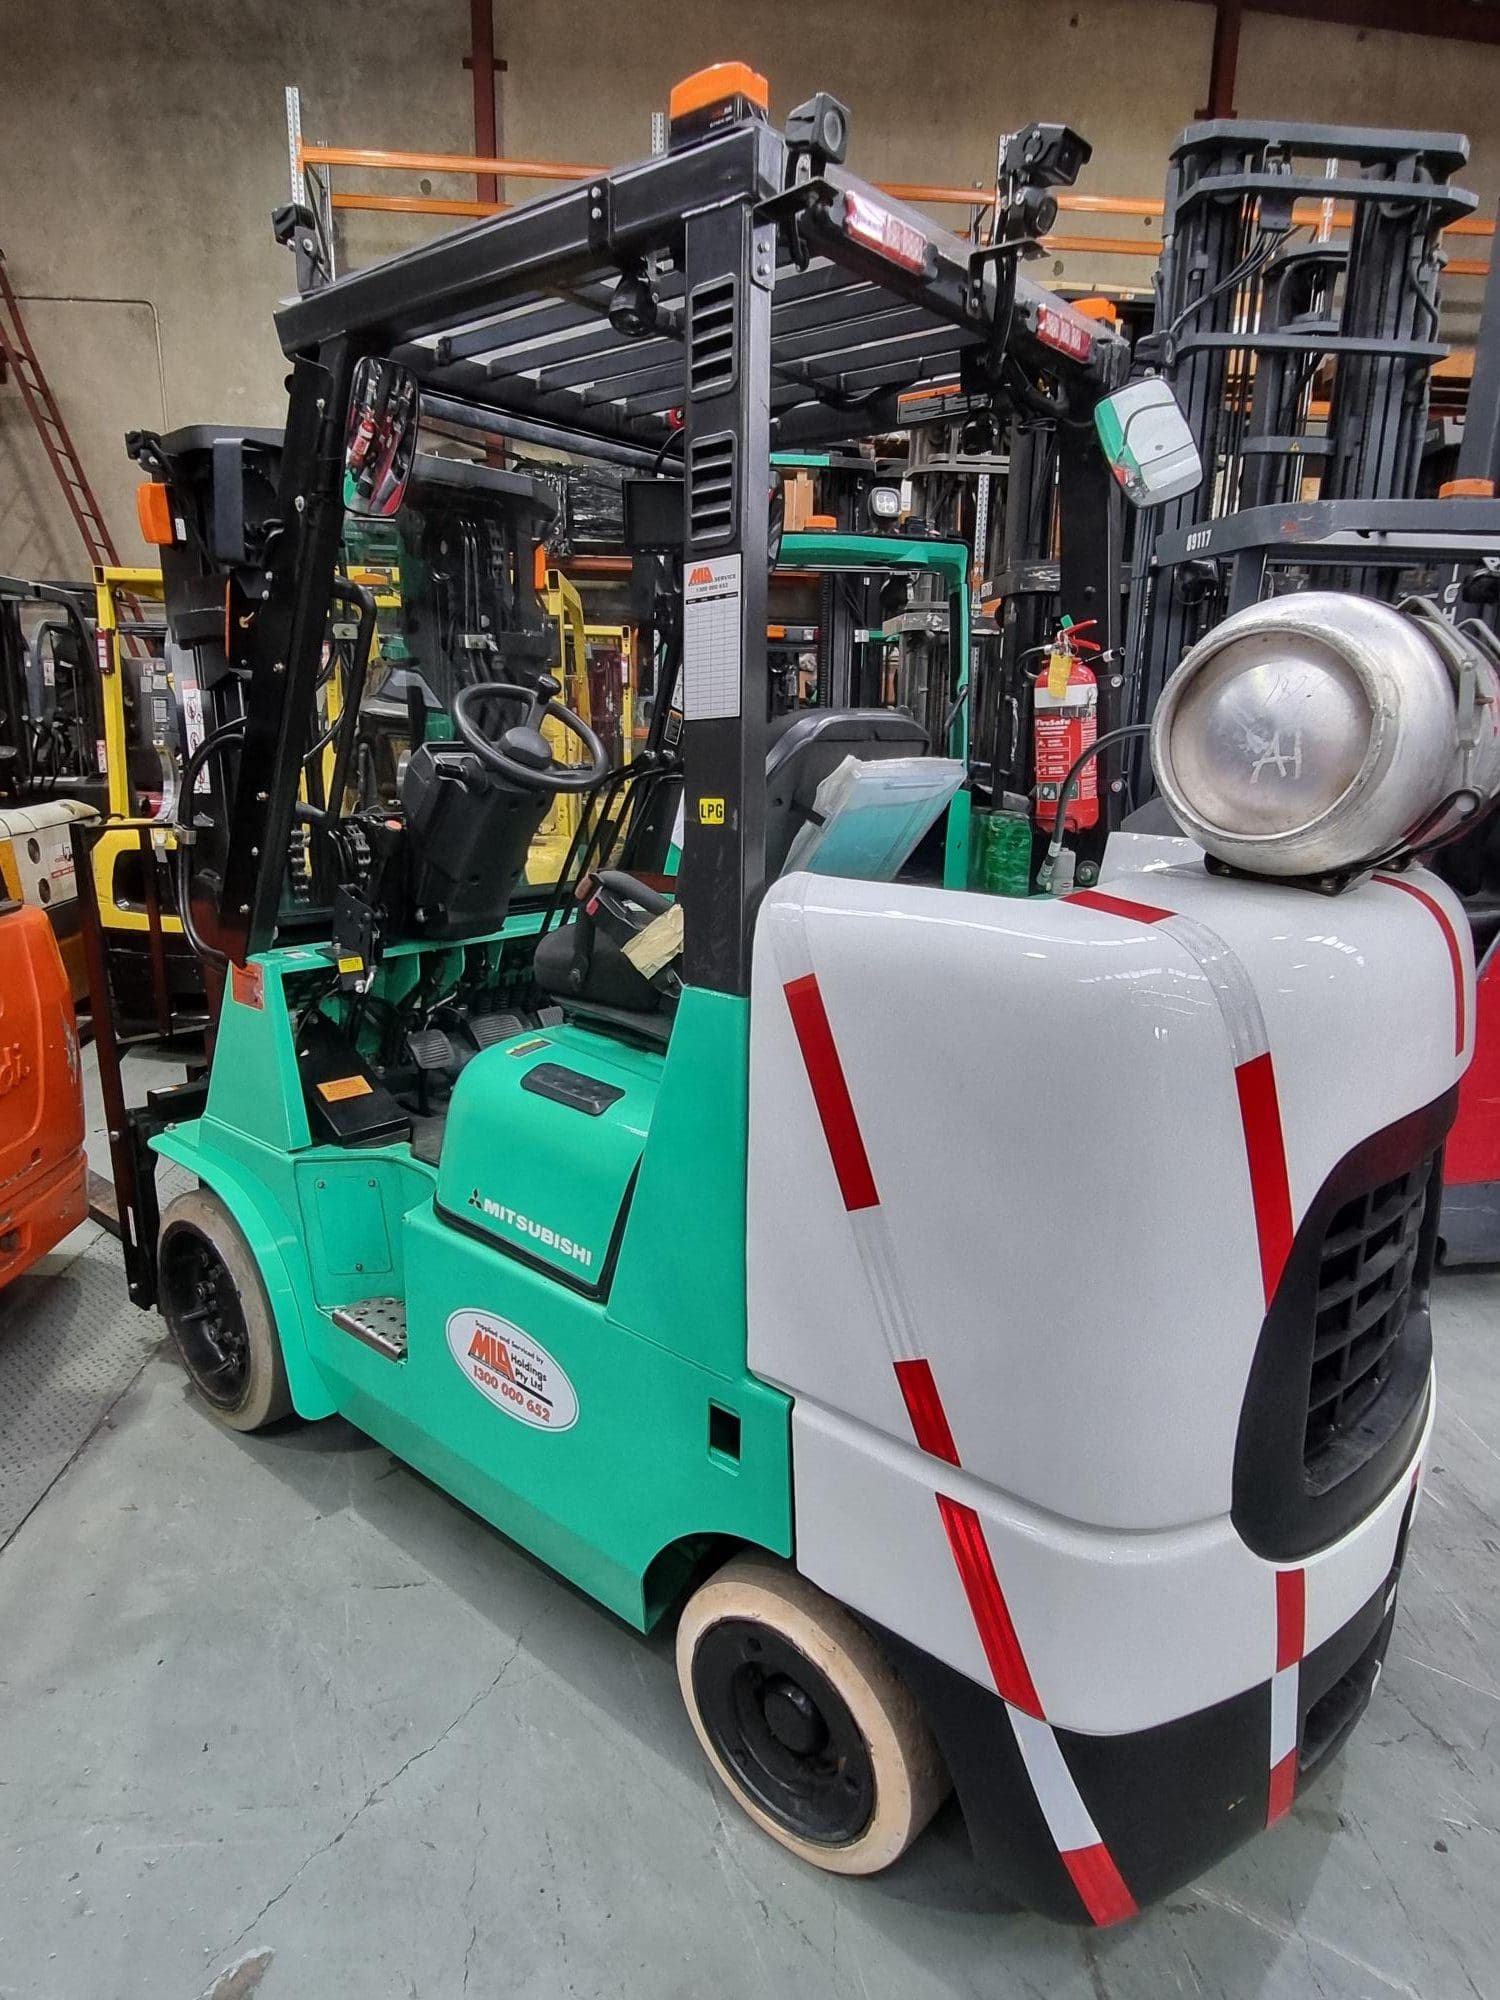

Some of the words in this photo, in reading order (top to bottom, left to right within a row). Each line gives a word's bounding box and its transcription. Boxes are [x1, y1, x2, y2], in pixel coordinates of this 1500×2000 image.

[1186, 529, 1212, 552] 89117
[700, 803, 723, 819] LPG
[483, 1198, 592, 1267] MITSUBISHI
[510, 1352, 547, 1382] Holdings
[515, 1368, 528, 1384] Pty
[530, 1376, 543, 1392] Ltd
[473, 1365, 499, 1389] 1300
[501, 1382, 524, 1406] 000
[526, 1399, 550, 1423] 652
